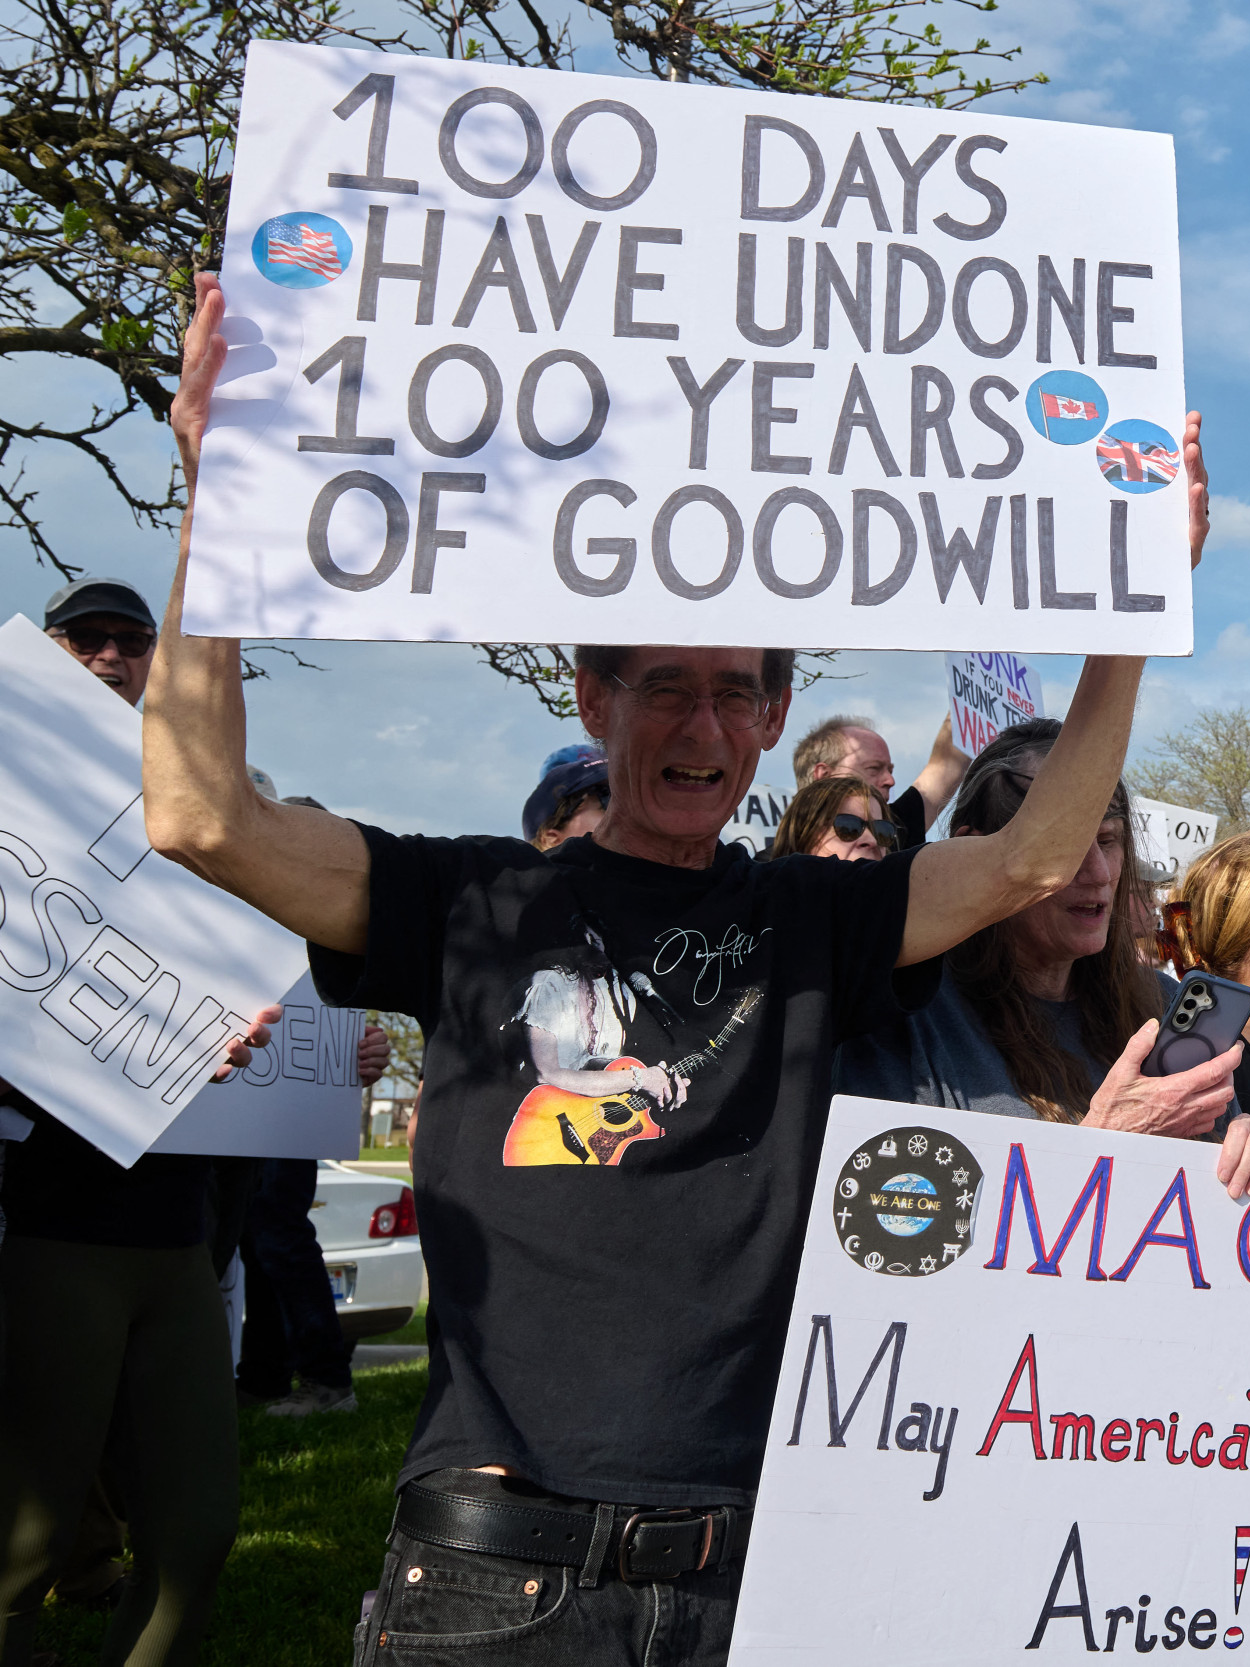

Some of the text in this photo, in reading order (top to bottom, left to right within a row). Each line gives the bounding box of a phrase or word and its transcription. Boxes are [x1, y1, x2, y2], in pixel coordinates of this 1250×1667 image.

[328, 72, 1008, 241] 100 DAYS
[356, 205, 1157, 369] HAVE UNDONE
[297, 336, 1024, 479] 100 YEARS
[307, 470, 1166, 612] OF GOODWILL
[952, 665, 999, 725] DRUNK
[964, 658, 1035, 717] IF YOU NEVER
[971, 652, 1032, 701] ONK
[870, 1193, 941, 1211] WE ARE ONE
[786, 1314, 960, 1502] May
